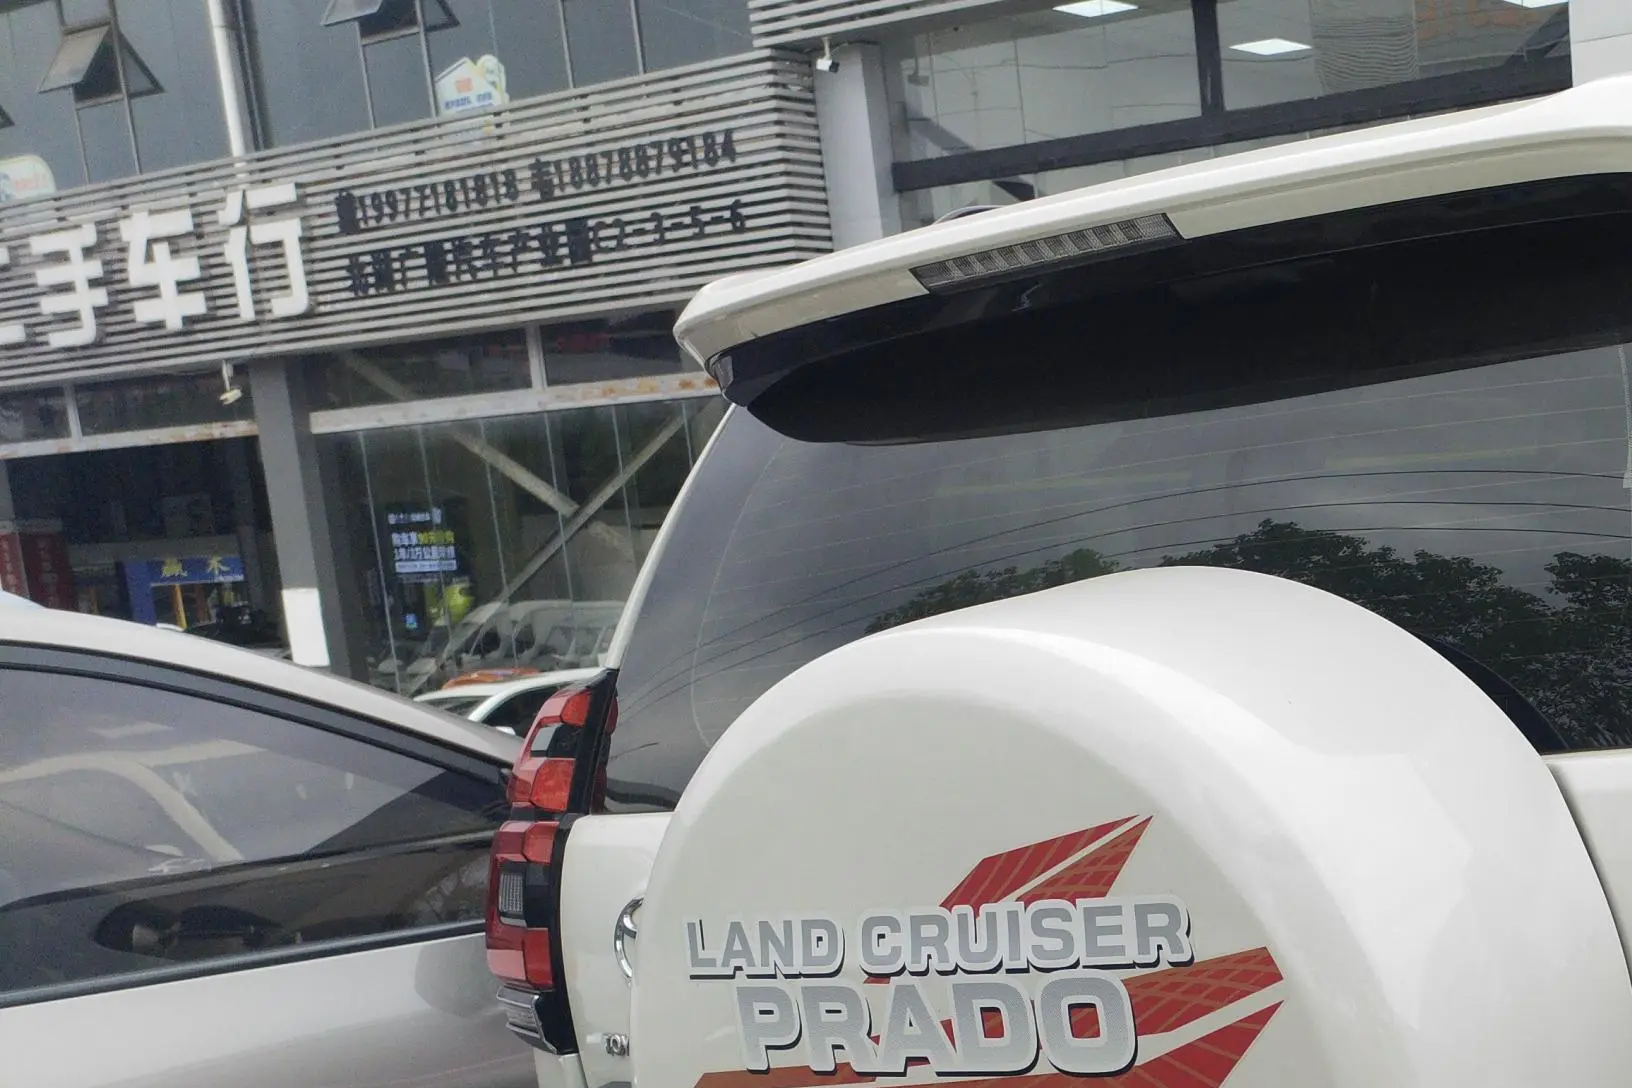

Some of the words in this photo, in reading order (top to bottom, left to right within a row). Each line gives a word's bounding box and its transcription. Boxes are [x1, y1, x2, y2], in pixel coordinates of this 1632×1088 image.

[684, 915, 845, 979] LAND
[858, 896, 1197, 978] CRUISER
[734, 969, 1139, 1079] PRADO
